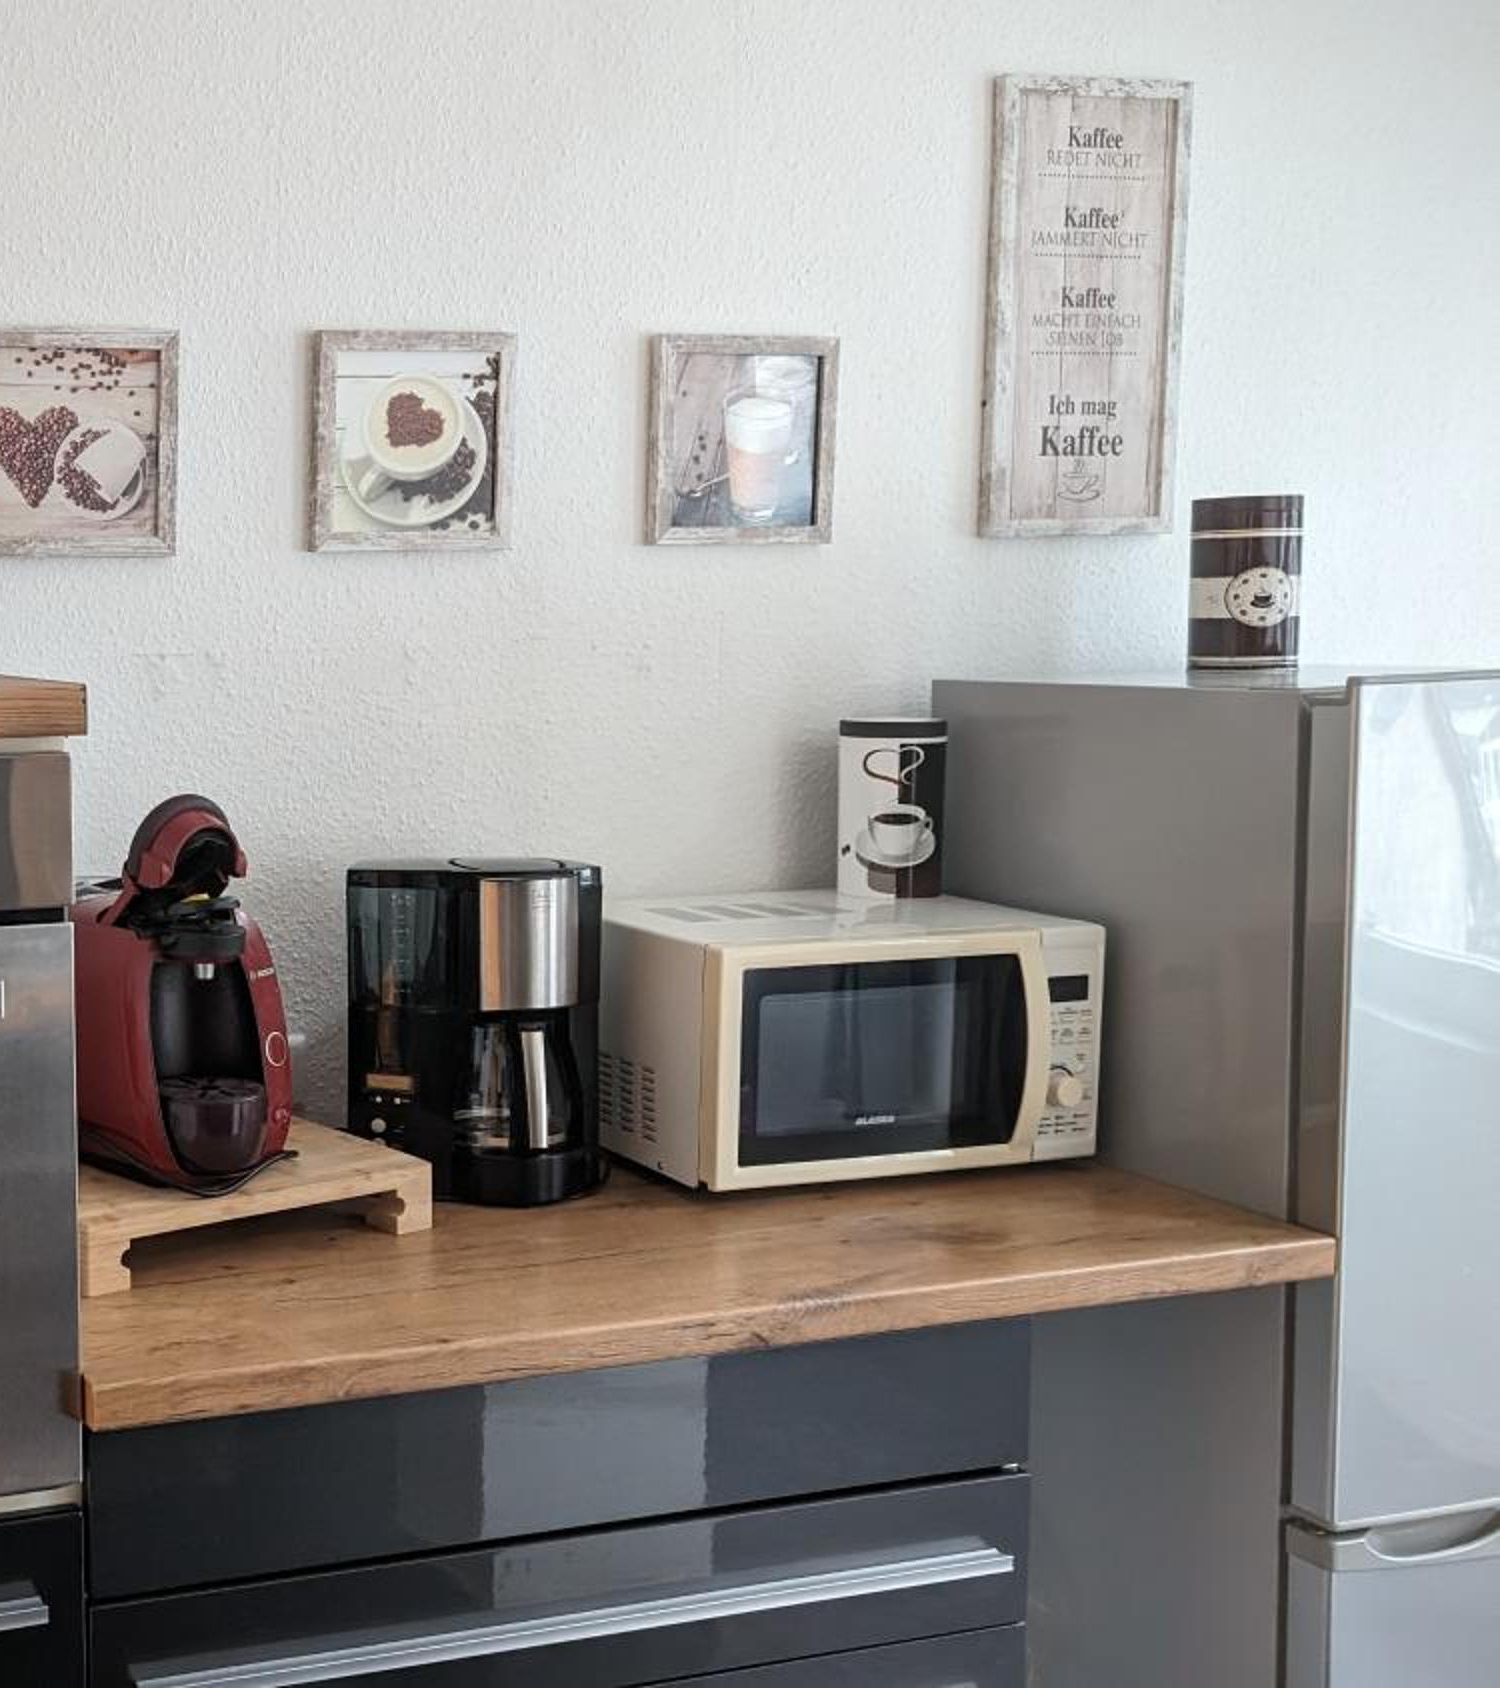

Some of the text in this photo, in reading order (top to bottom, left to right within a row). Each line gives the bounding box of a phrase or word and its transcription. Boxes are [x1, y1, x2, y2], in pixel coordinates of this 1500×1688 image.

[1067, 125, 1124, 149] Kaffee
[1047, 149, 1141, 169] REDET NICHT
[1064, 206, 1119, 229] Kaffee
[1031, 231, 1148, 249] JAMMERT NICHT
[1061, 286, 1117, 309] Kaffee
[1049, 394, 1118, 418] Ich mag
[1039, 425, 1124, 457] Kaffee
